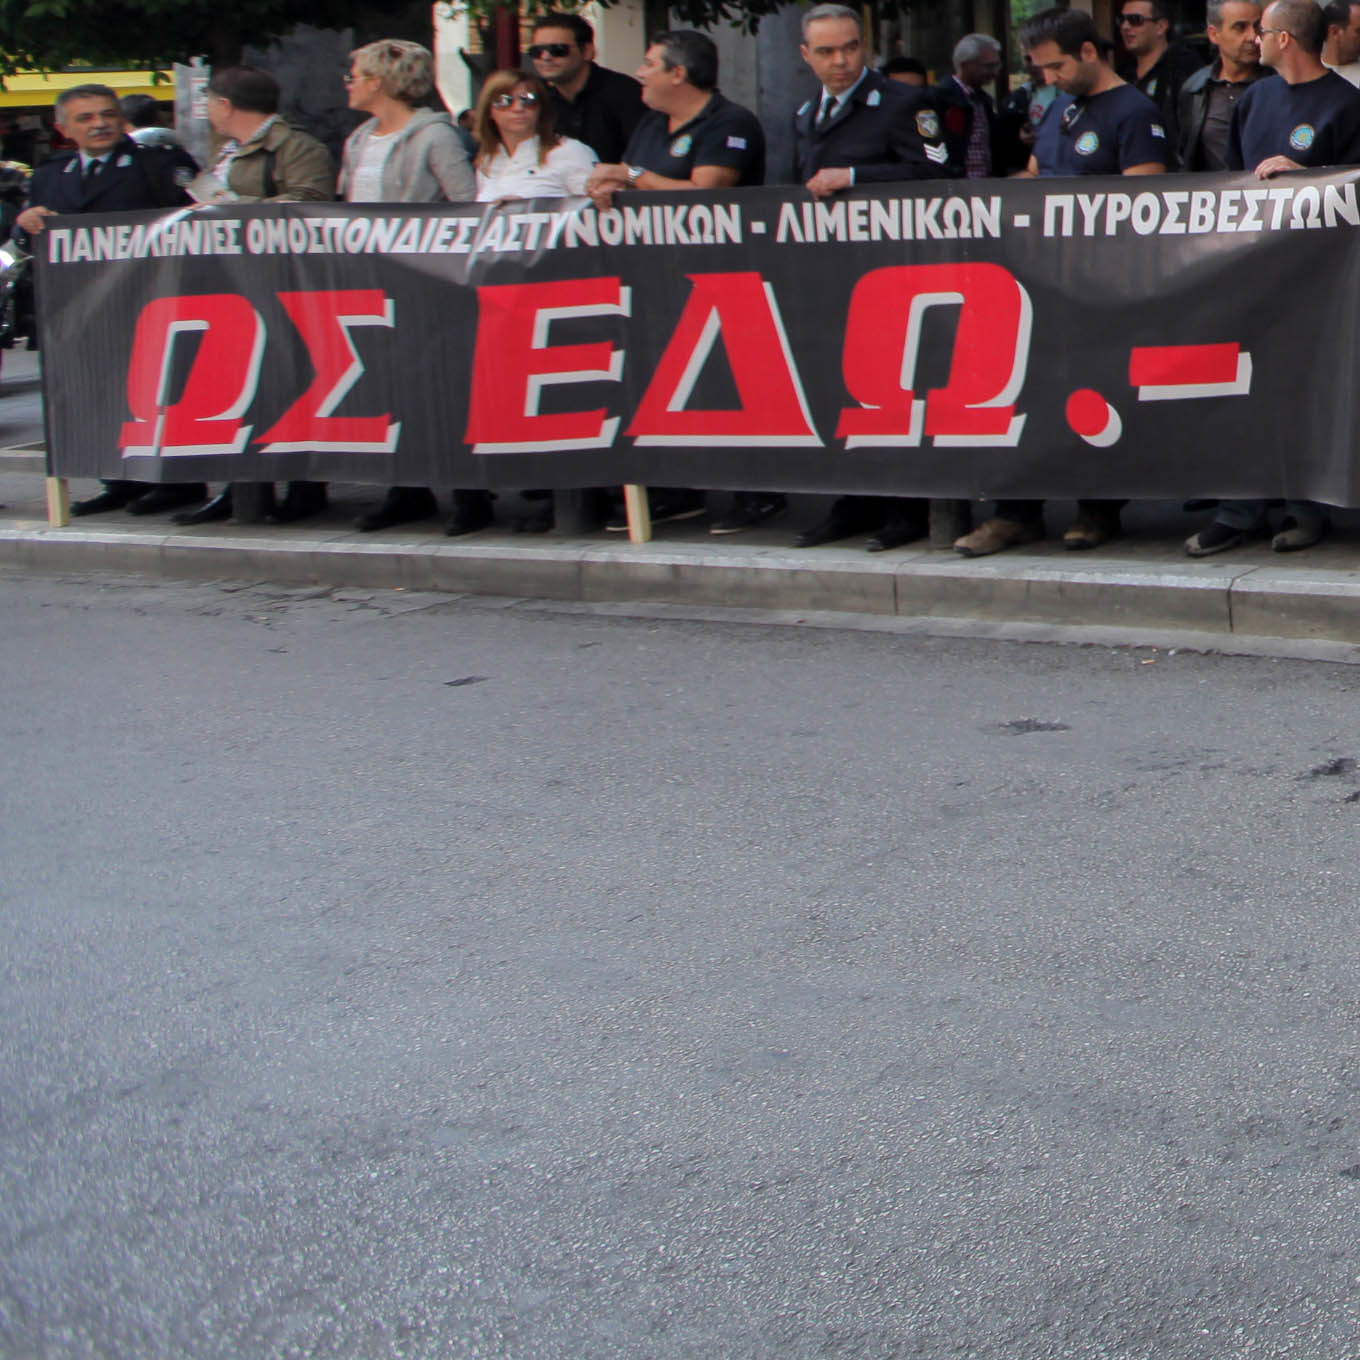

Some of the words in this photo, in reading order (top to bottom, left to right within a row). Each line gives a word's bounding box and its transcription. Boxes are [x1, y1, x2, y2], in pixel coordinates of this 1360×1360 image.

[246, 216, 479, 255] ΟΜΟΣΠΟΝΔΙΕΣ
[776, 195, 1001, 243] ΛΙΜΕΝΙΚΩΝ
[1043, 183, 1360, 238] ΠΥΡΟΣΒΕΣΤΩΝ
[118, 289, 398, 457] ΩΣ
